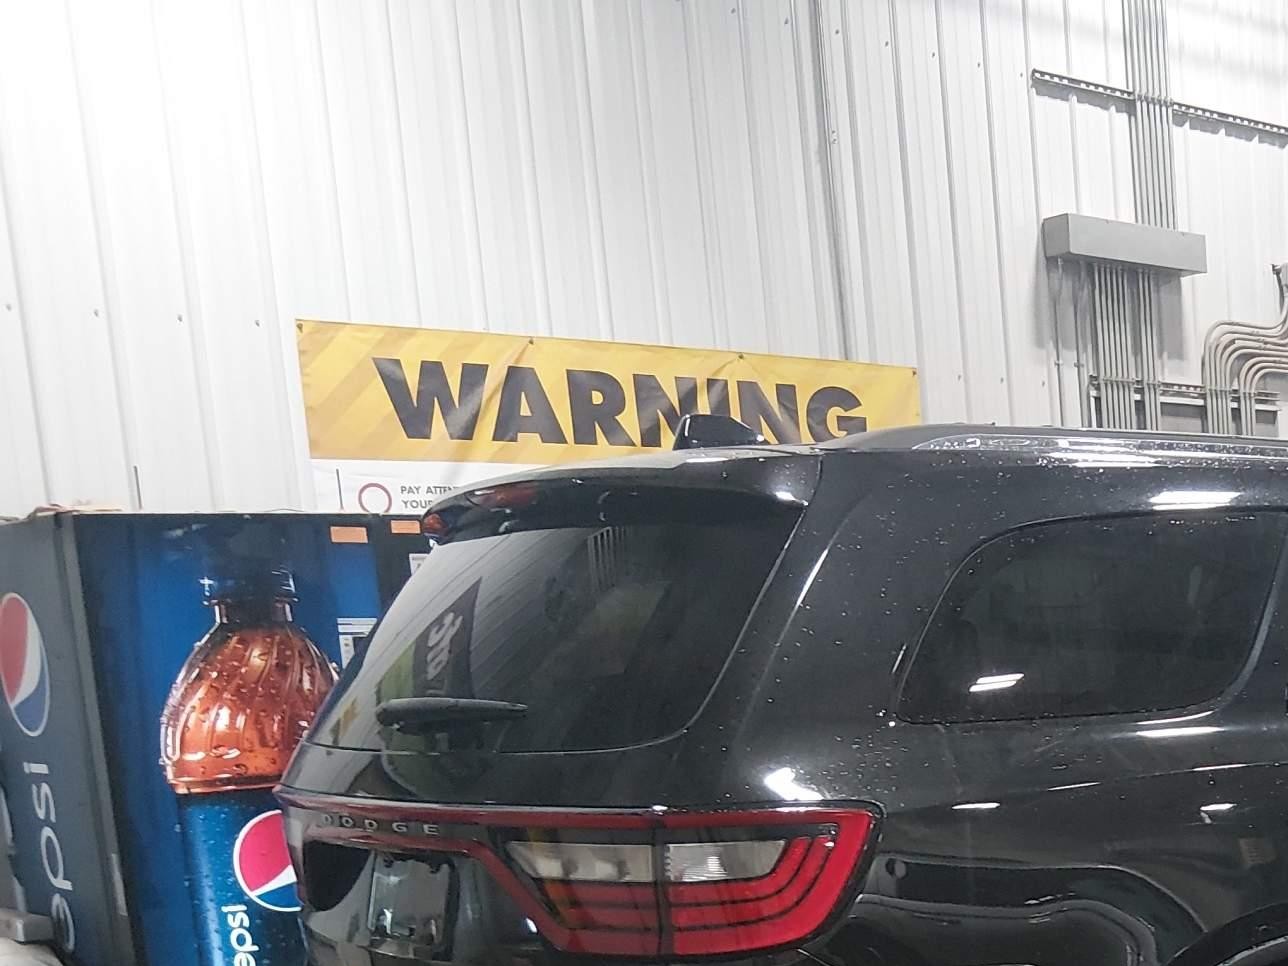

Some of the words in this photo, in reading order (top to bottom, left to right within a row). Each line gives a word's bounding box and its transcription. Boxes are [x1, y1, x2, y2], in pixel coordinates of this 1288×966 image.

[372, 357, 867, 448] WARNING
[400, 485, 421, 495] PAY
[320, 813, 439, 835] DODGE
[24, 761, 76, 951] epsi
